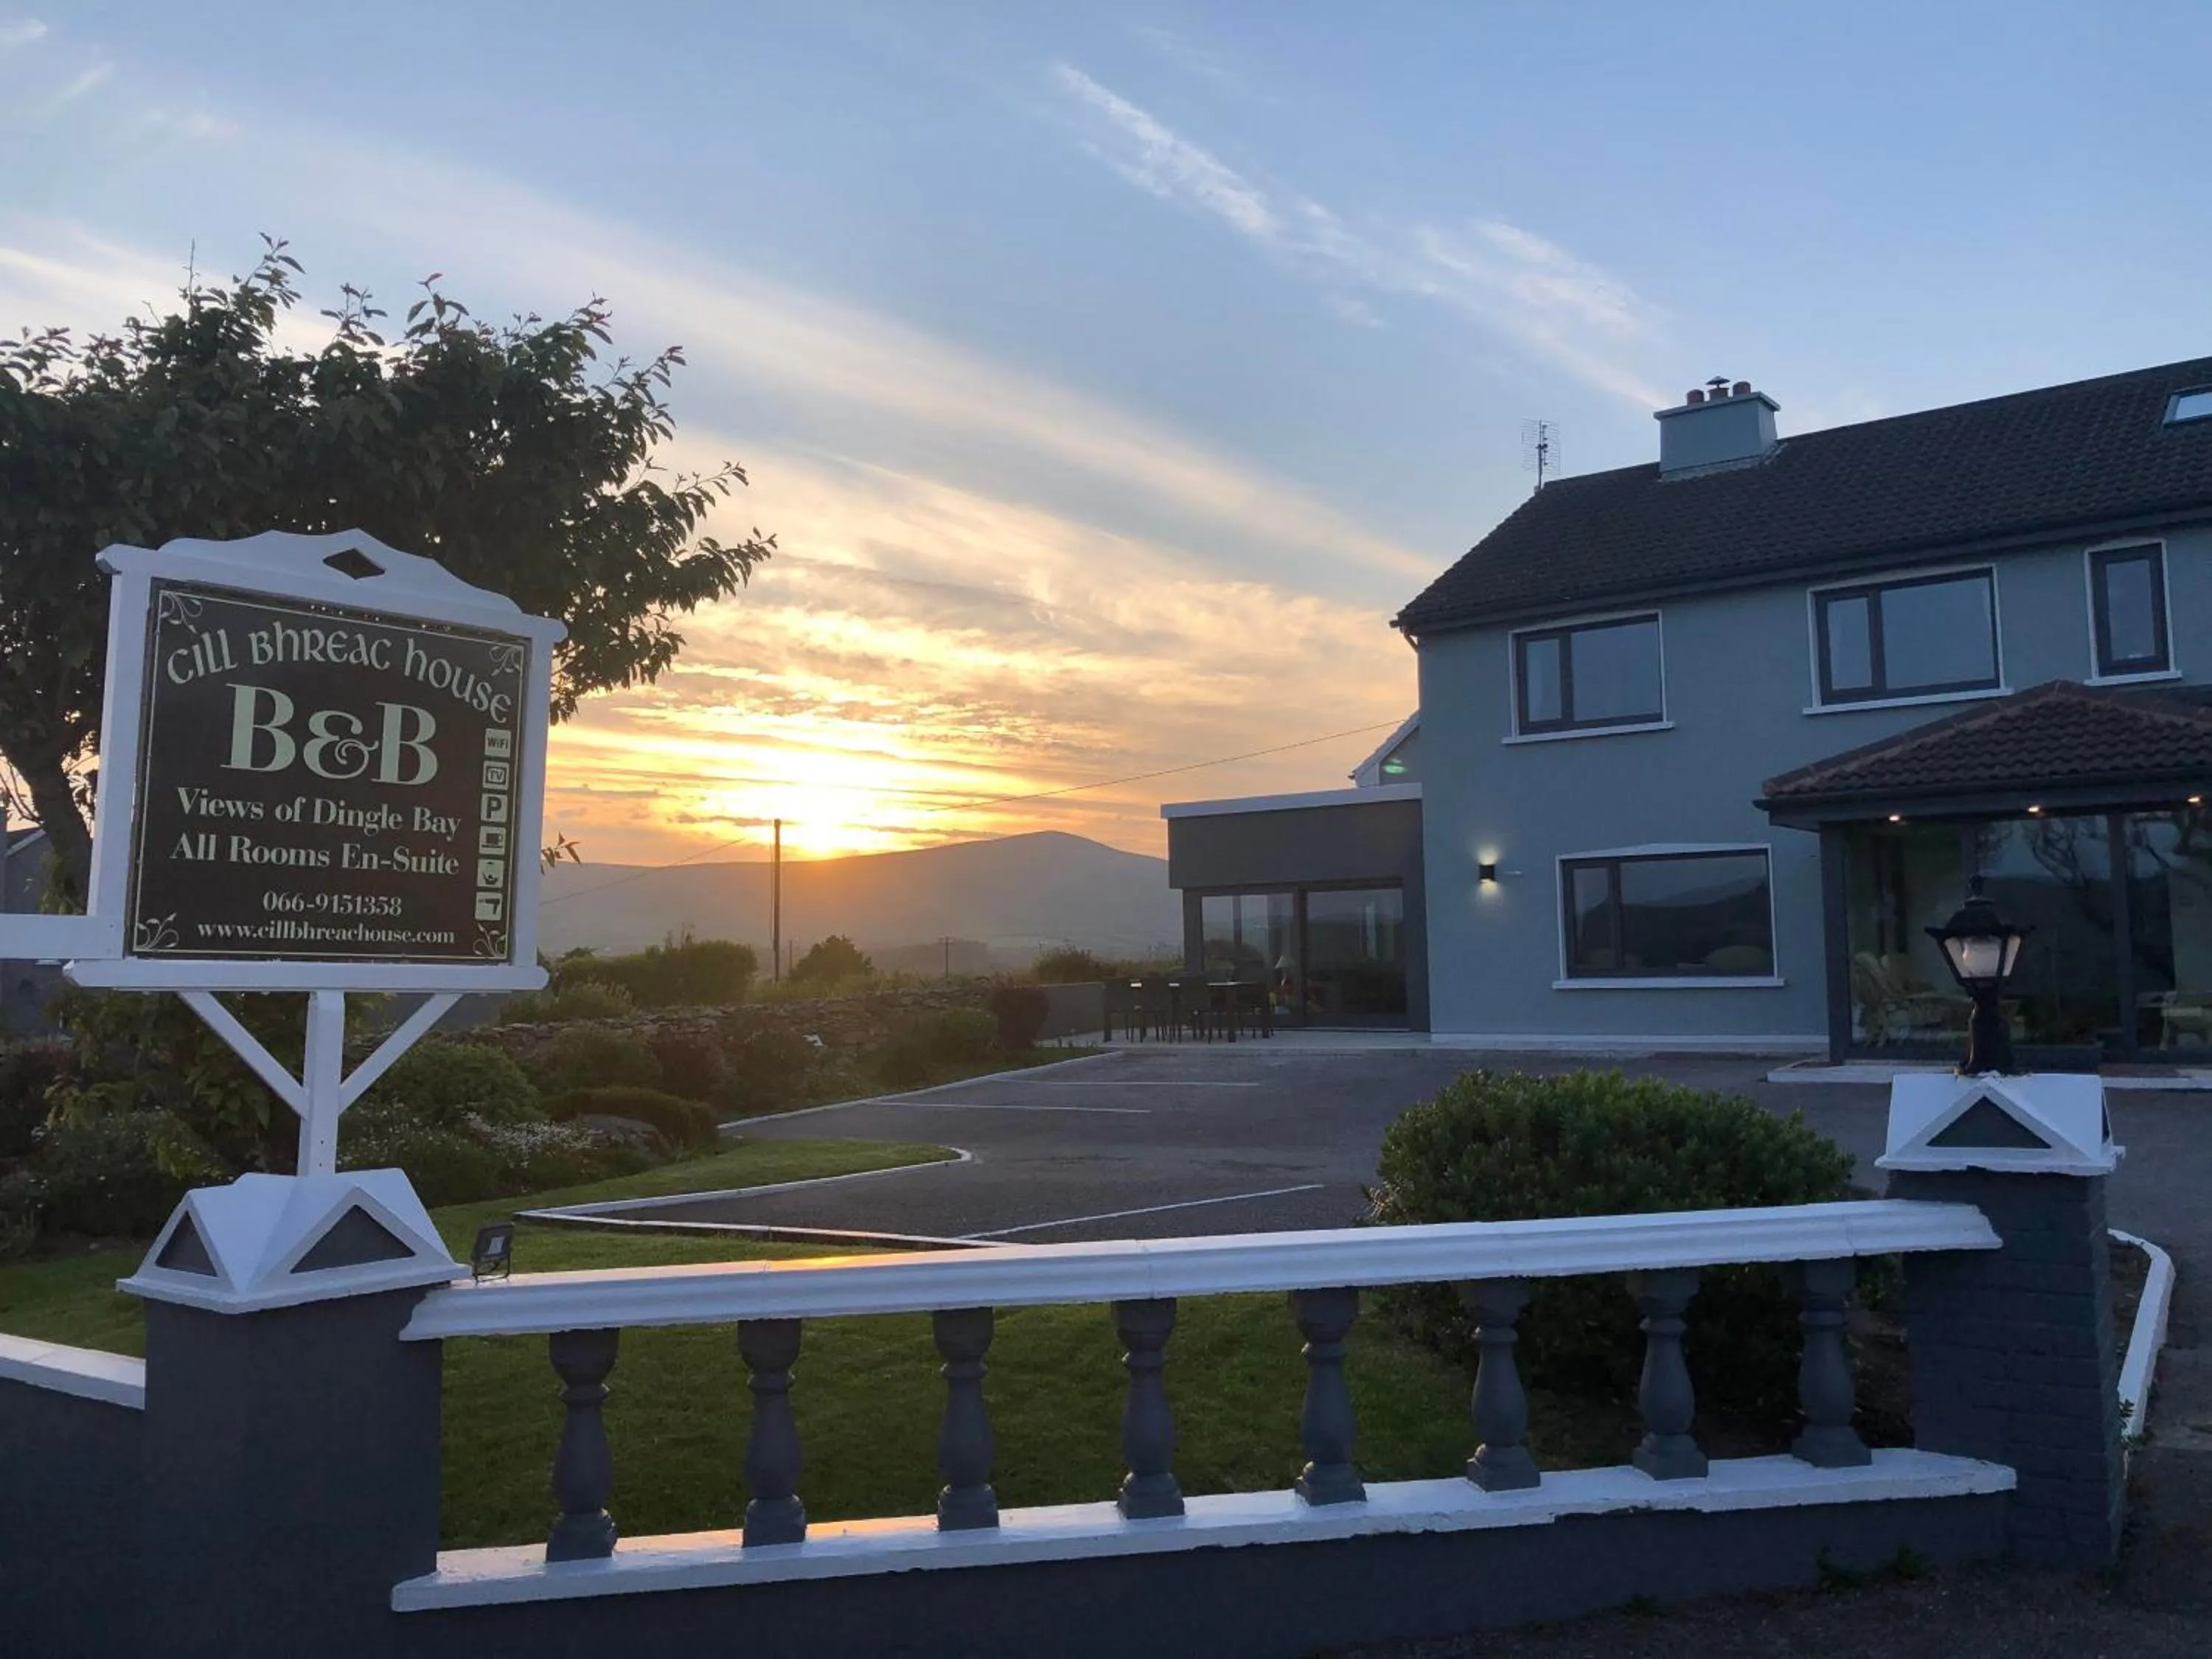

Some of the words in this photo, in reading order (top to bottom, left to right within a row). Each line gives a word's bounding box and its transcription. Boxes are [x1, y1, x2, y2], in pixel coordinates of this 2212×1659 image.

[220, 683, 438, 785] B&B
[490, 770, 502, 780] TV
[177, 787, 263, 820] Views
[275, 796, 306, 822] of
[313, 798, 403, 836] Dingle
[413, 806, 462, 841] Bay
[487, 797, 501, 818] P
[170, 832, 216, 860] All
[229, 835, 330, 867] Rooms
[341, 843, 459, 875] En-Suite
[262, 890, 402, 917] 066-9151358
[198, 919, 455, 944] www.cillbhreachouse.com
